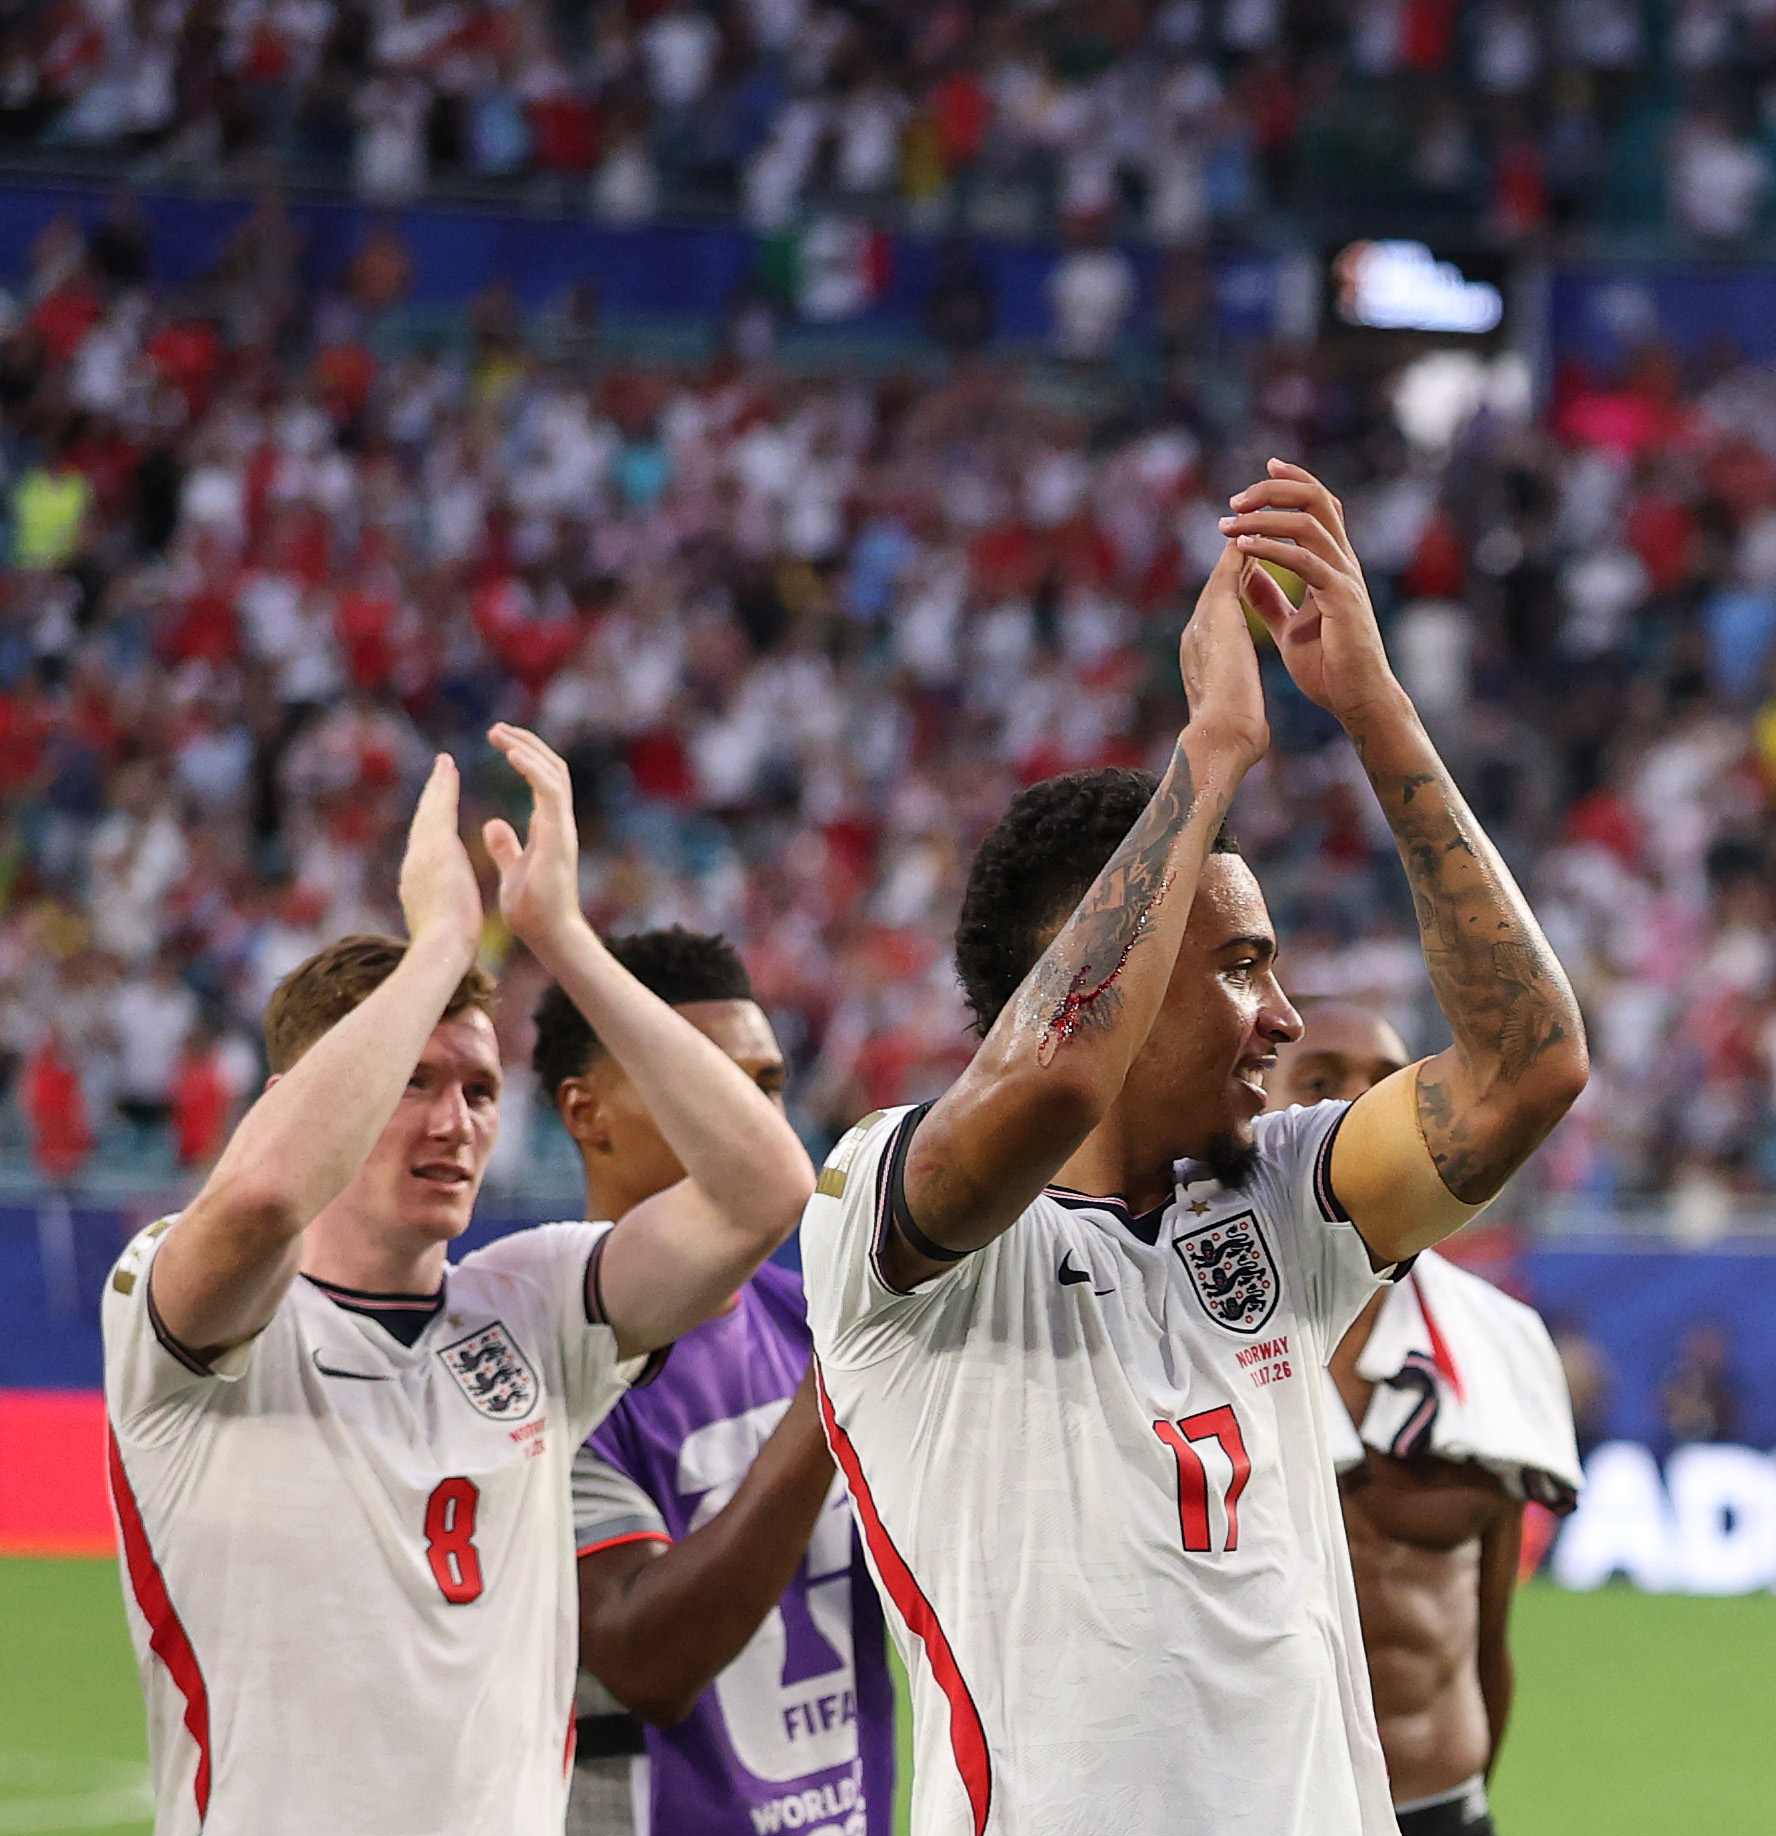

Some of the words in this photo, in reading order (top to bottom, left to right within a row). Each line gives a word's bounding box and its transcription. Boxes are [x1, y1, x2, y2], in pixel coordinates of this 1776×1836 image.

[1235, 1335, 1289, 1368] NORWAY
[1152, 1403, 1252, 1552] 17
[424, 1476, 485, 1605] 8
[751, 1777, 859, 1836] WORLD
